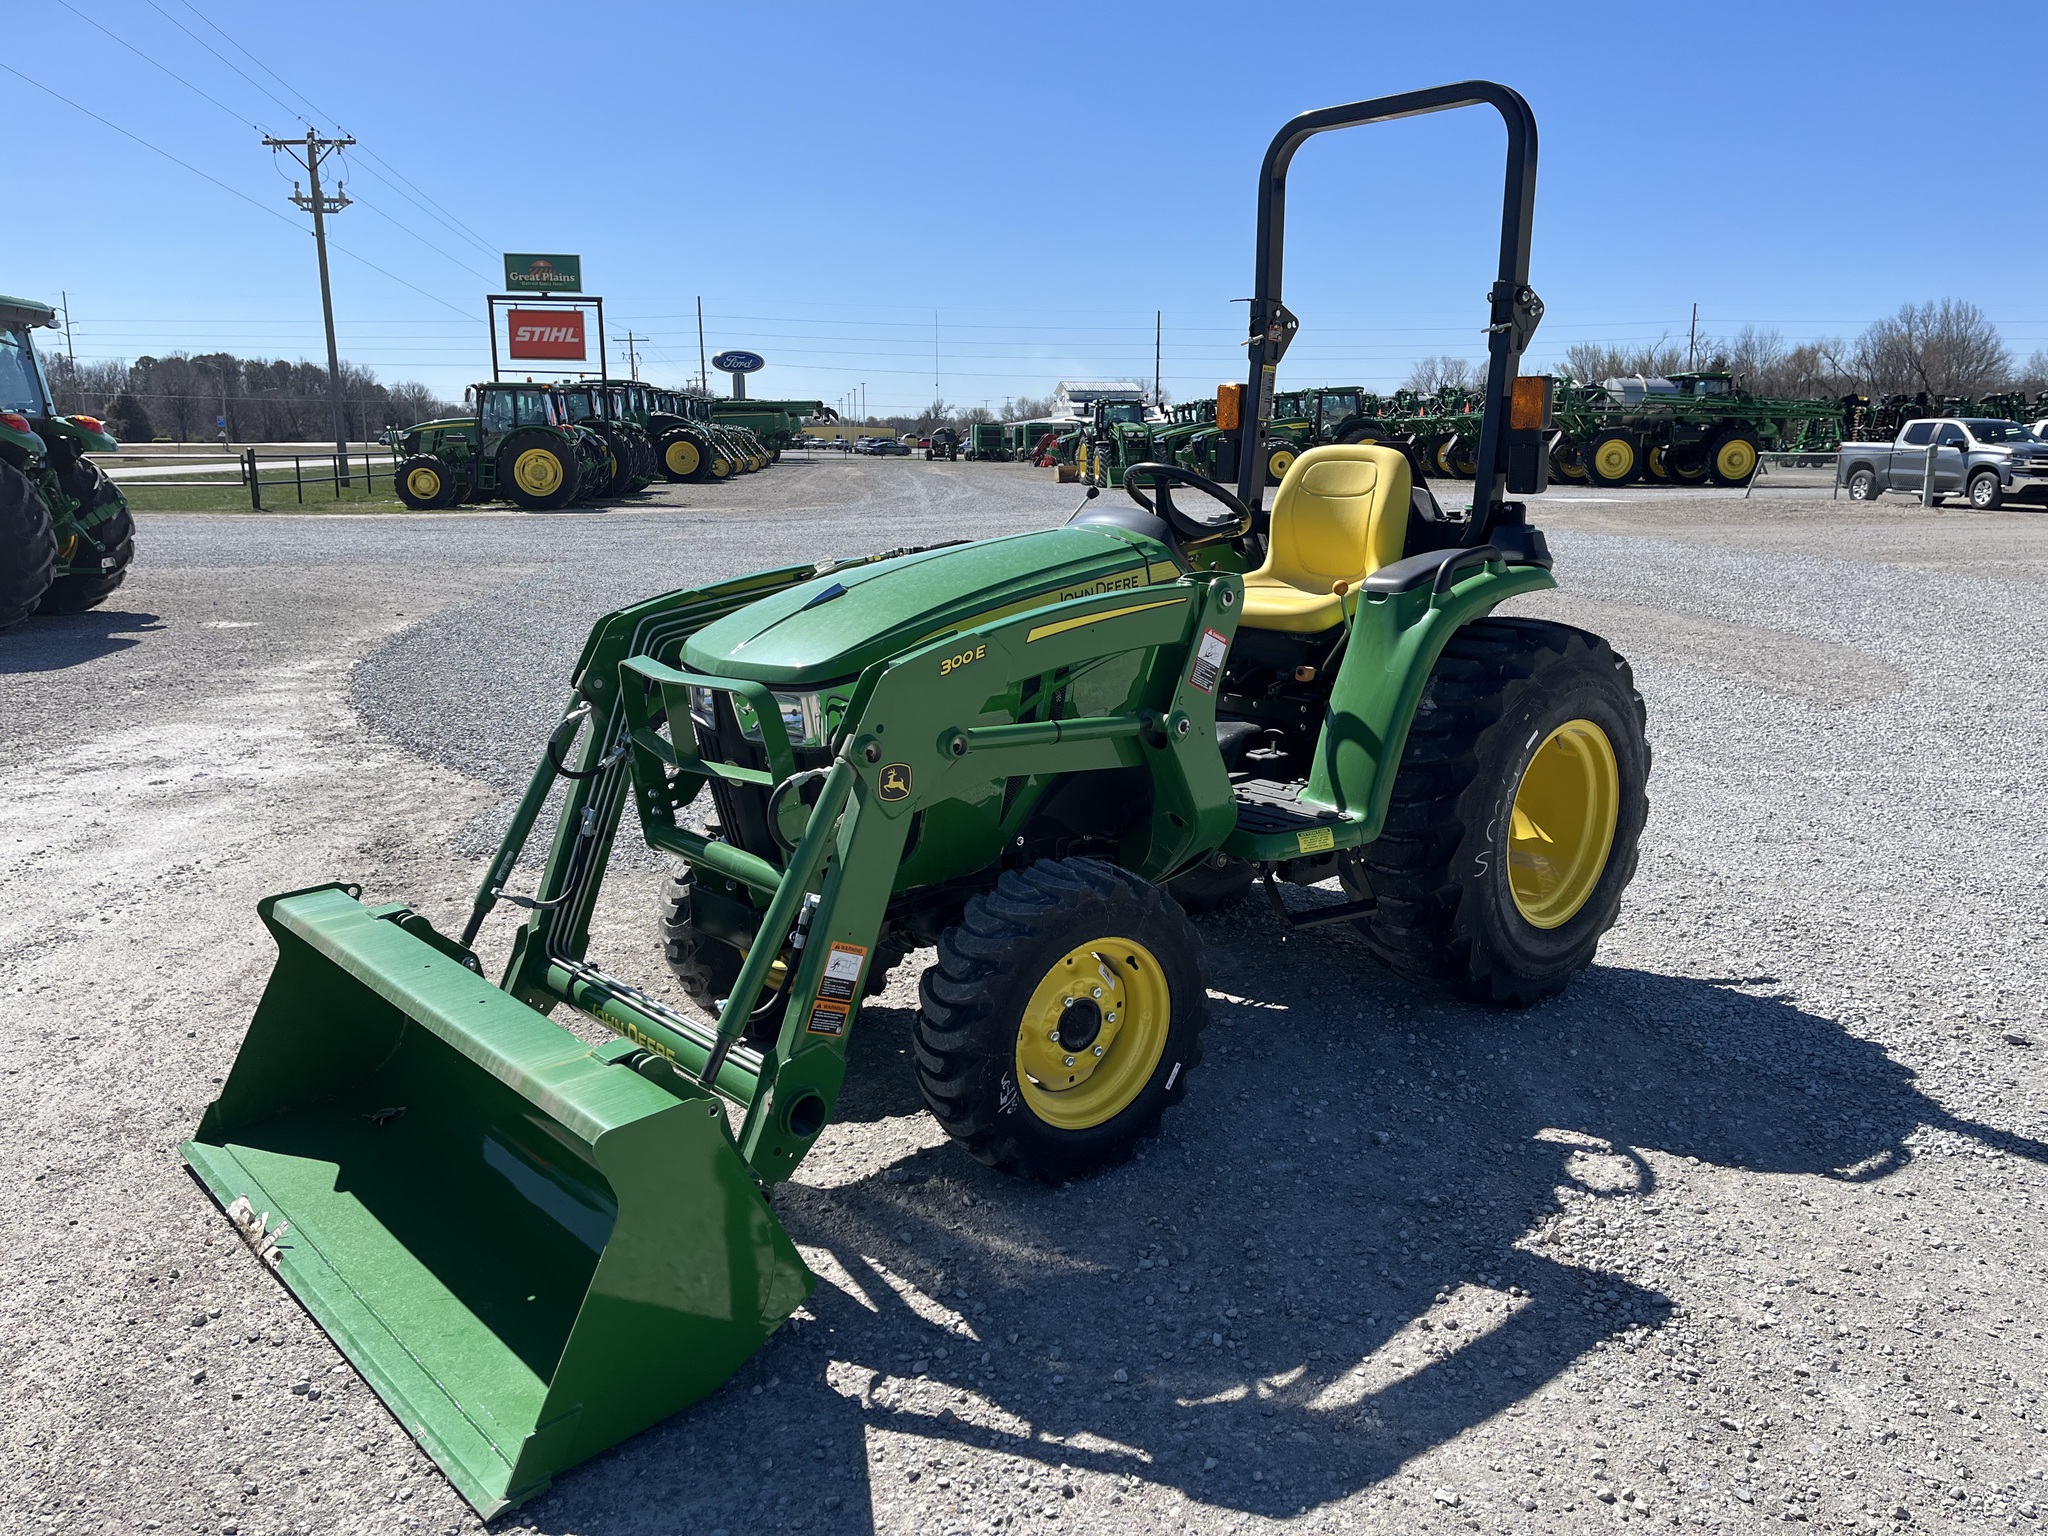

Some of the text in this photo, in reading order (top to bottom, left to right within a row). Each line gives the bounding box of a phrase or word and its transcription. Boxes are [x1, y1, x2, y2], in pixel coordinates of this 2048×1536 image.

[509, 272, 575, 282] Great Plains
[515, 326, 579, 342] STIHL
[723, 354, 753, 368] Ford
[1095, 575, 1139, 594] DEERE
